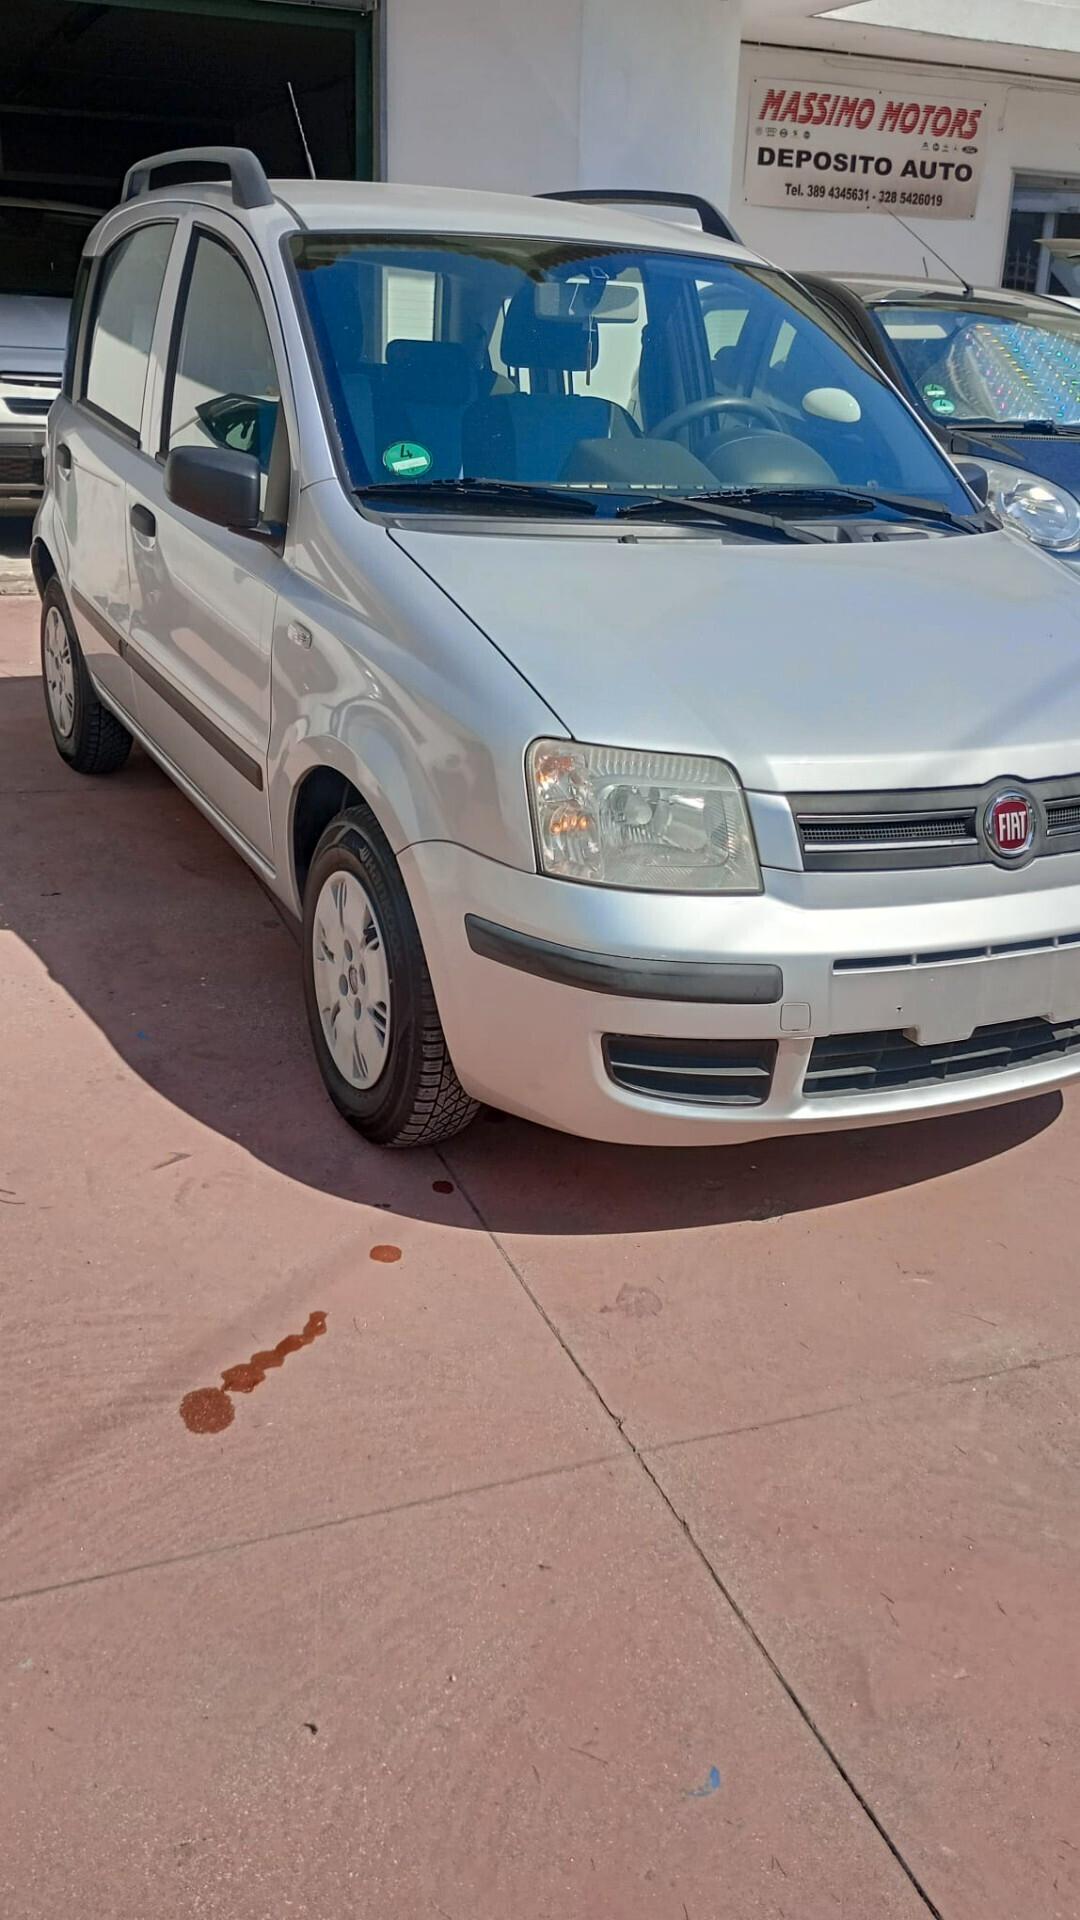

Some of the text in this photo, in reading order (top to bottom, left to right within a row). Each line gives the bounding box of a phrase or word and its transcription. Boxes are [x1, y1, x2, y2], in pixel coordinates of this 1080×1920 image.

[758, 88, 982, 140] MASSIMO MOTORS
[757, 146, 973, 182] DEPOSITO AUTO
[785, 183, 804, 196] Tel.
[807, 185, 826, 198] 389
[828, 186, 869, 202] 4345631
[878, 190, 897, 203] 328
[900, 192, 943, 207] 5426019
[401, 444, 412, 458] 4
[998, 811, 1026, 842] FIAT
